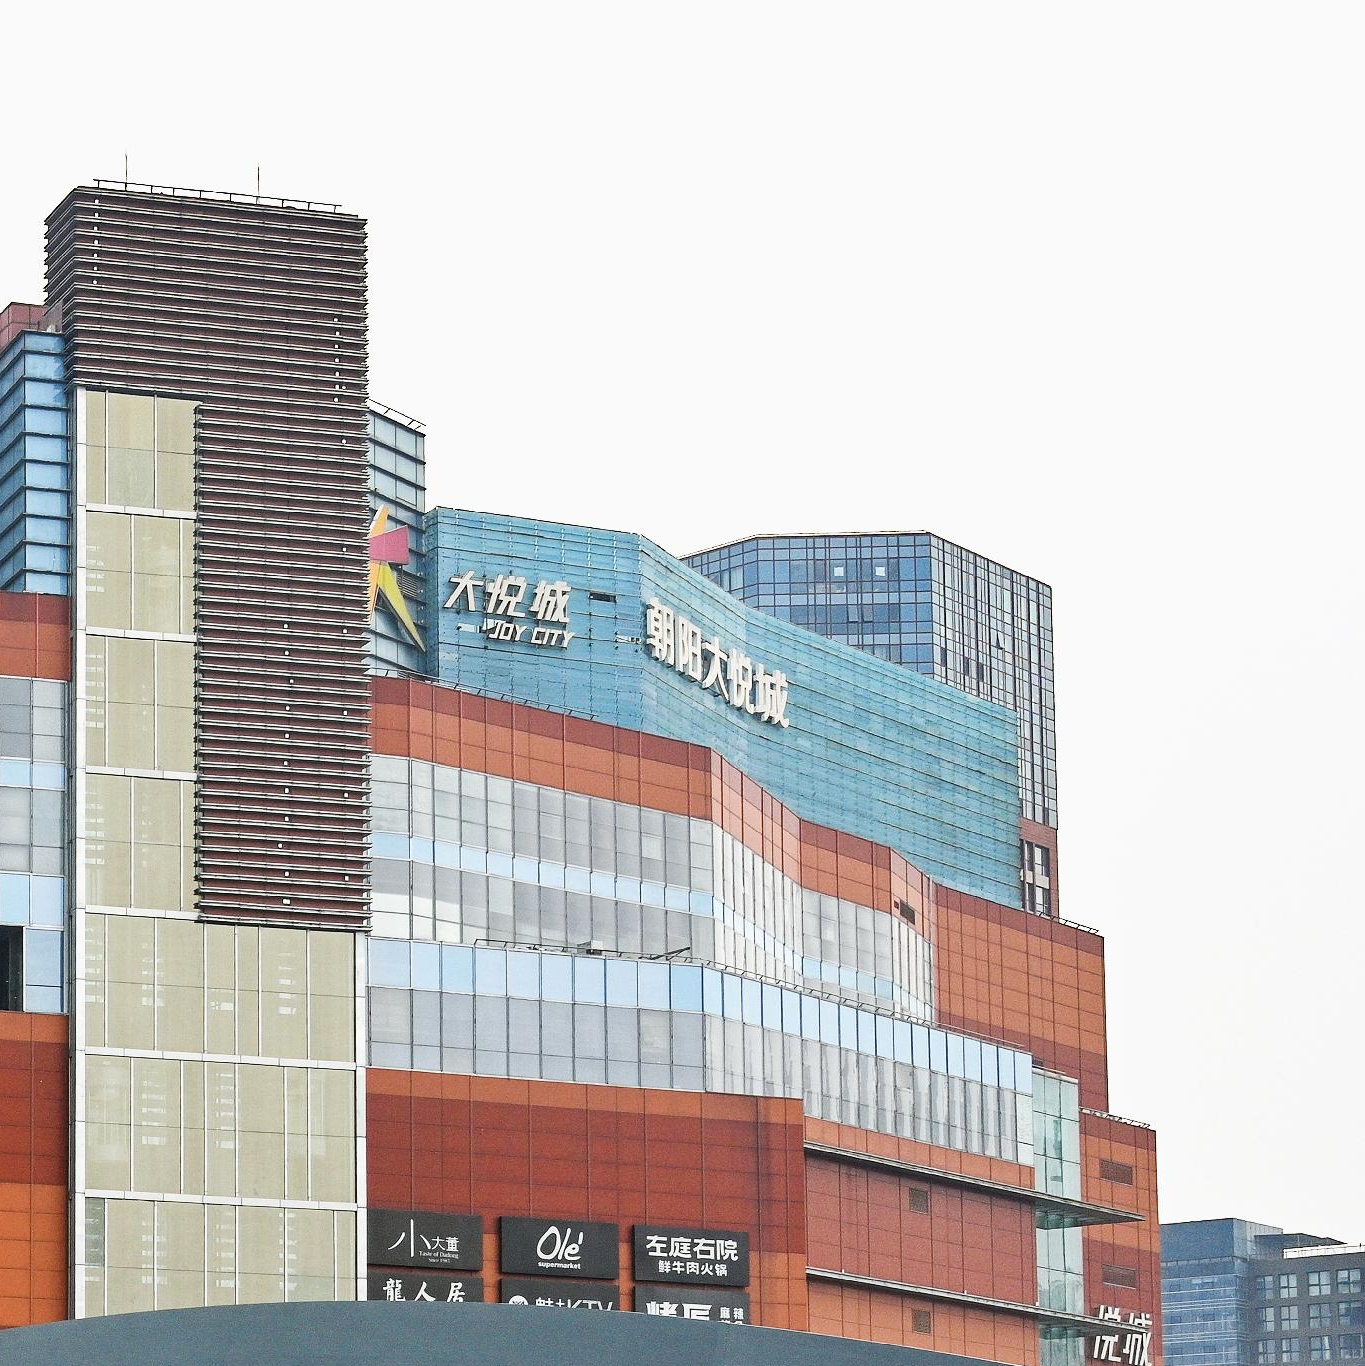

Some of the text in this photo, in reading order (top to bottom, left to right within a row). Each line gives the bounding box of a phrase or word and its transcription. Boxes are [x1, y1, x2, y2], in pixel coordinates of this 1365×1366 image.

[444, 570, 572, 624] 大悦城
[486, 620, 575, 649] JOY CITY
[646, 596, 790, 729] 朝阳大悦城
[646, 1235, 738, 1261] 左庭右院
[538, 1261, 581, 1270] supermarket
[658, 1260, 728, 1277] 鲜牛肉火锅
